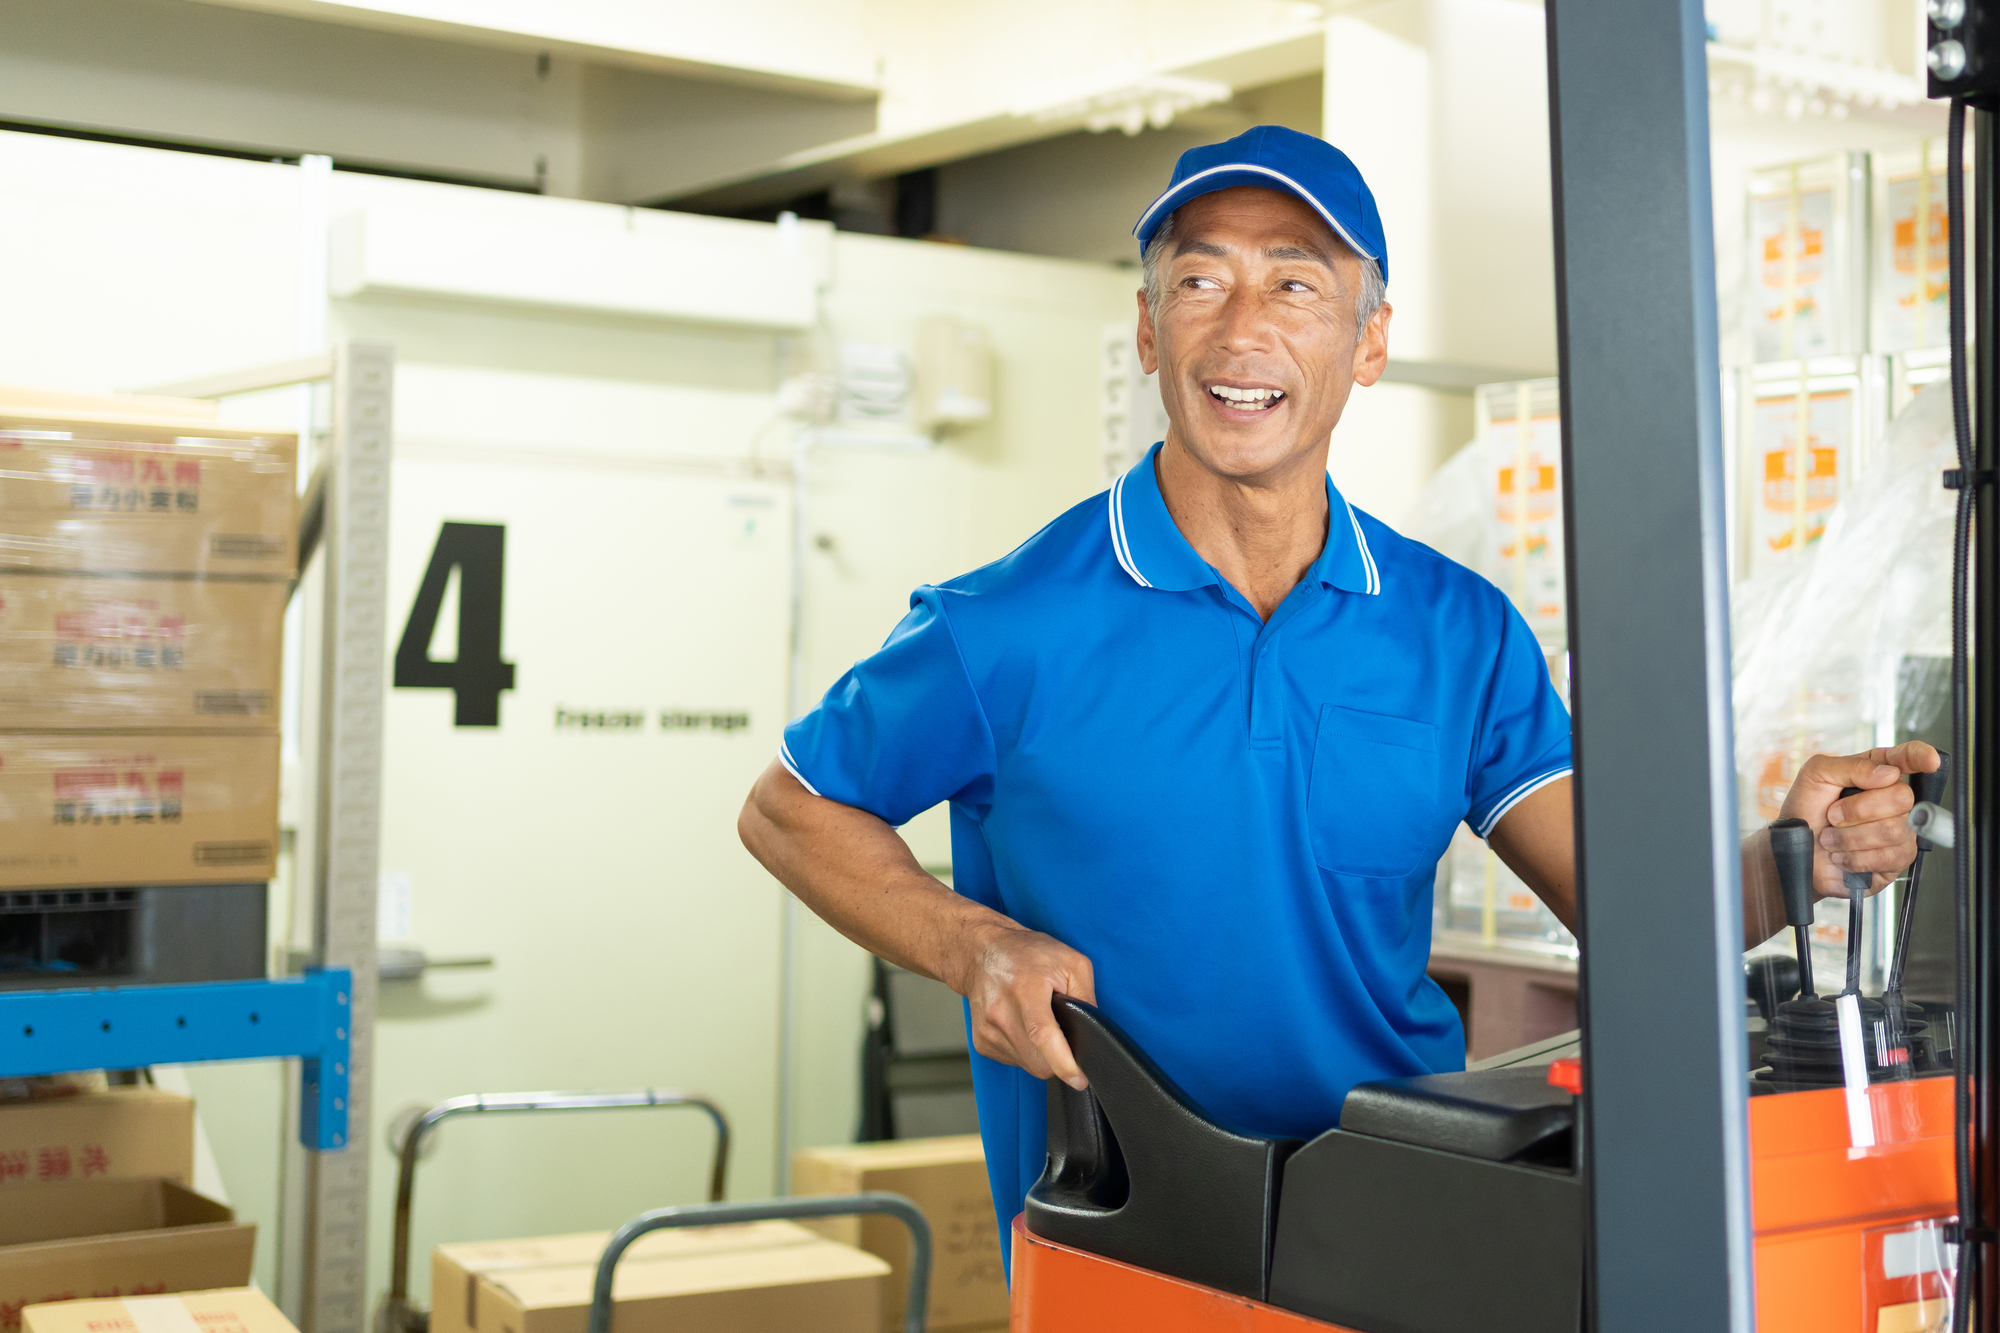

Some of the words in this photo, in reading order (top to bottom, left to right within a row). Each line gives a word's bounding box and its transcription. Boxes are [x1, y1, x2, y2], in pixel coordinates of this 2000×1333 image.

[394, 522, 515, 726] 4
[555, 704, 644, 730] freezer
[660, 706, 750, 733] storage
